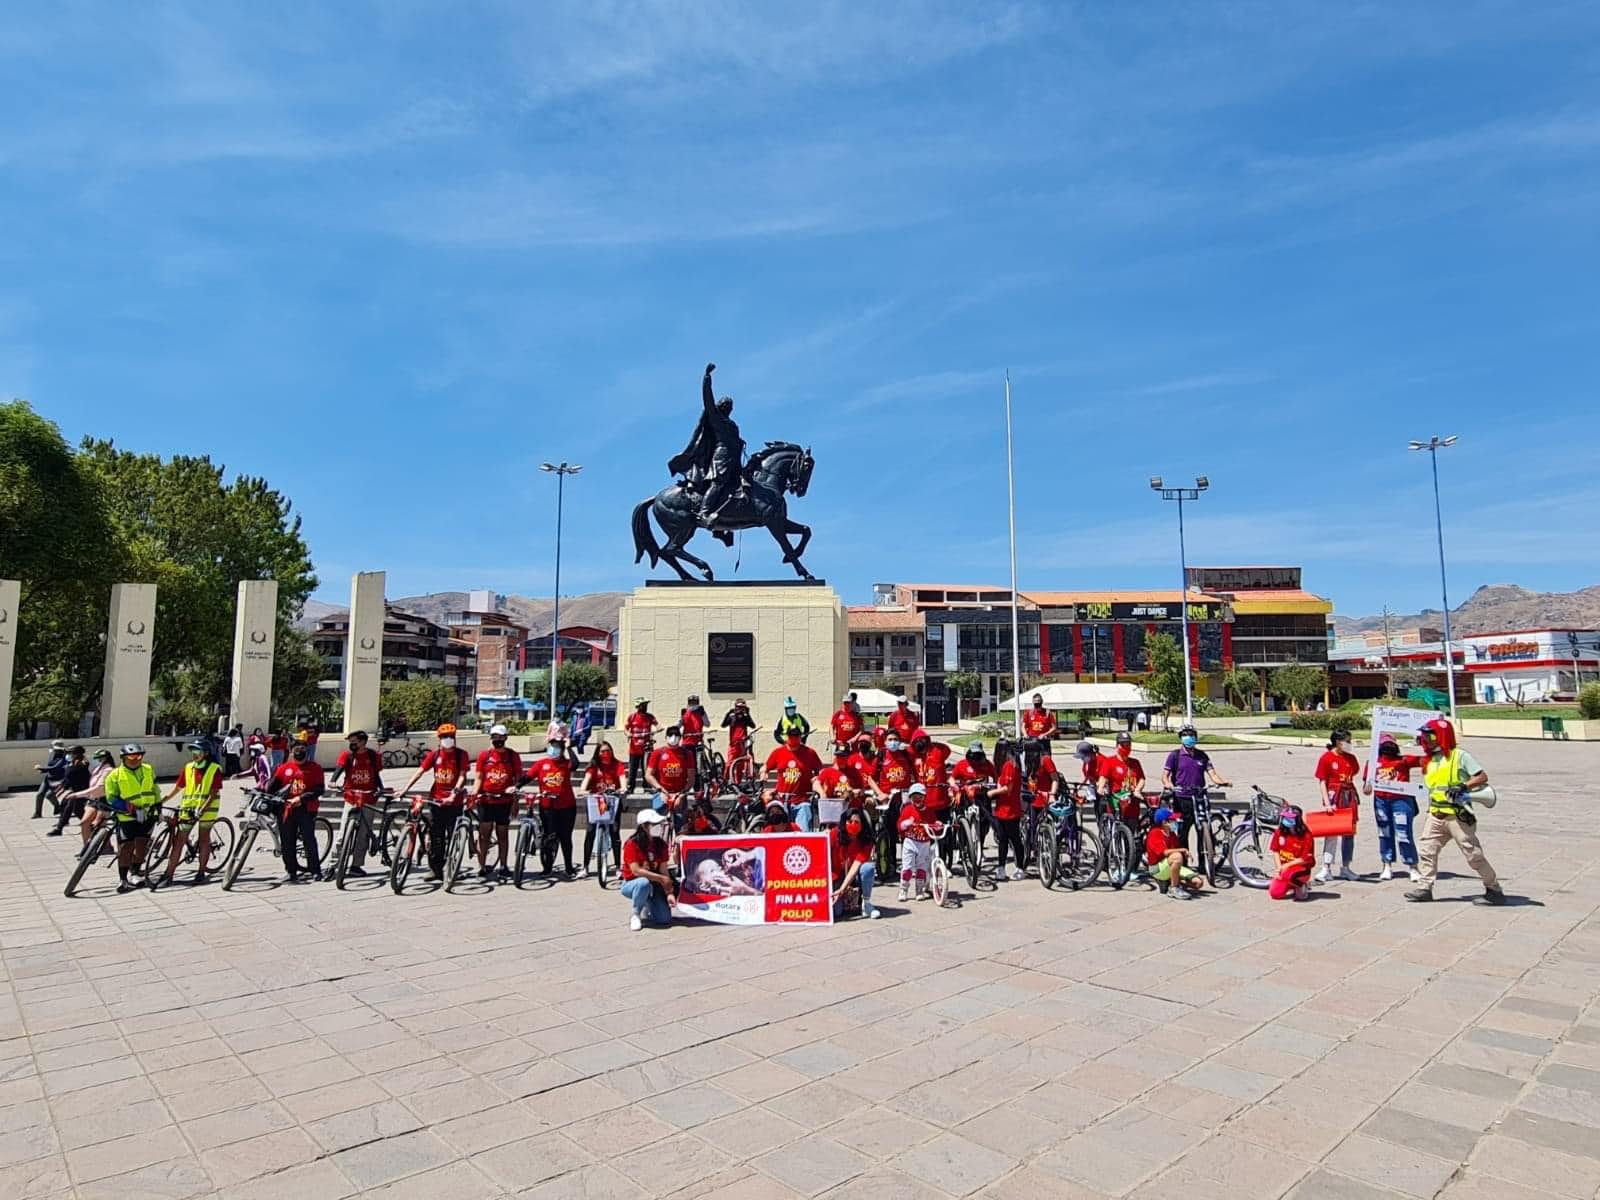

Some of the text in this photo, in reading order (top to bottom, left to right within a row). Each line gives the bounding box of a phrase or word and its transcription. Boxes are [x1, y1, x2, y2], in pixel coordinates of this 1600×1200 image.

[1131, 607, 1146, 615] JUST
[767, 878, 827, 889] PONGAMOS
[775, 894, 819, 904] FIN A LA
[715, 902, 742, 911] Rotary
[781, 909, 813, 919] POLIO
